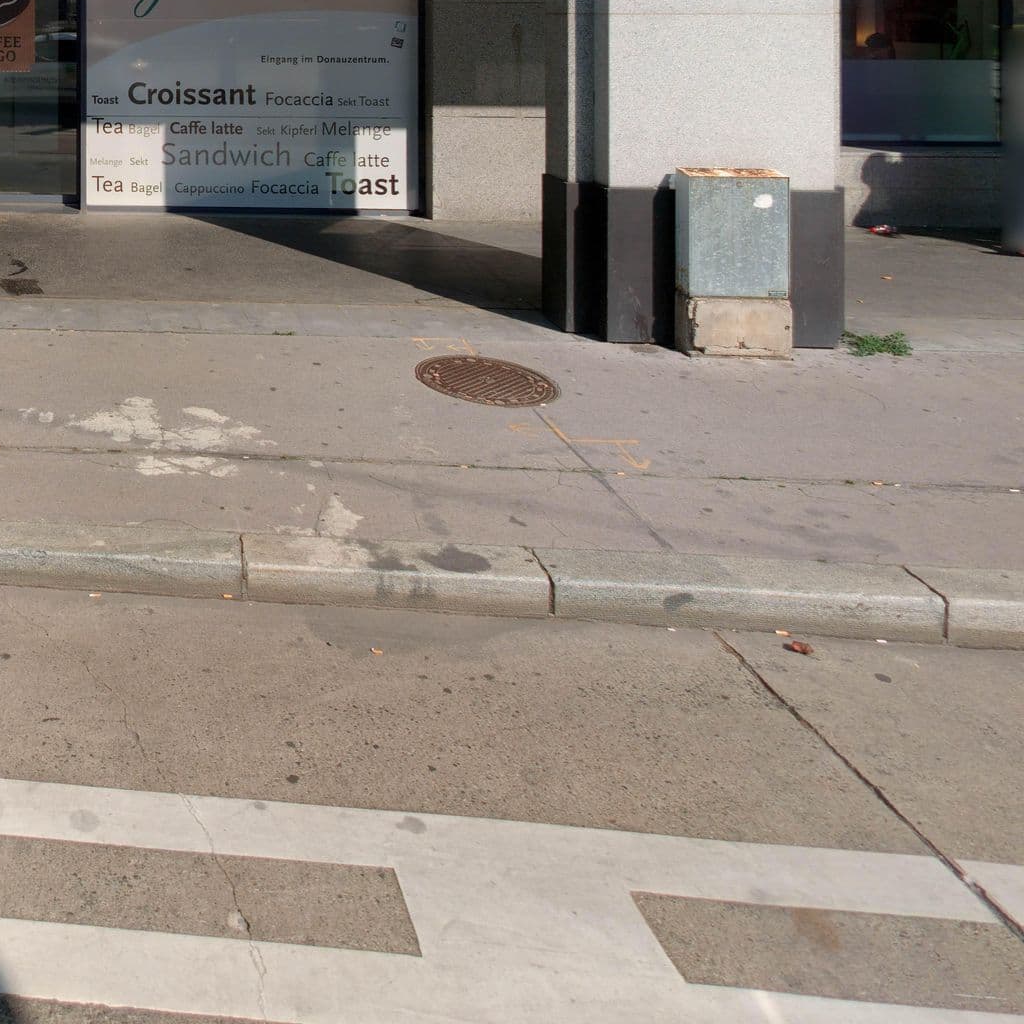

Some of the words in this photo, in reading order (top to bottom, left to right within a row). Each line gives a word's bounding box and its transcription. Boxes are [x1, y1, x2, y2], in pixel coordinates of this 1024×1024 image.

[261, 55, 298, 66] Eingang
[302, 55, 313, 64] im
[316, 55, 390, 64] Donauzentrum.
[92, 95, 119, 105] Toast
[128, 81, 256, 105] Croissant
[265, 92, 333, 106] Focaccia
[337, 97, 357, 107] Sekt
[359, 95, 390, 107] Toast
[91, 117, 123, 134] Tea
[128, 123, 160, 137] Bagel
[170, 121, 207, 135] Caffe
[211, 121, 243, 135] latte
[256, 125, 275, 136] Sekt
[280, 125, 317, 138] Kipferl
[322, 120, 391, 140] Melange
[89, 157, 123, 168] Melange
[130, 156, 149, 166] Sekt
[162, 141, 291, 166] Sandwich
[304, 150, 347, 167] Caffe
[353, 151, 389, 167] latte
[91, 175, 123, 193] Tea
[131, 182, 162, 195] Bagel
[174, 183, 245, 196] Cappuccino
[251, 180, 319, 195] Focaccia
[325, 172, 399, 195] Toast
